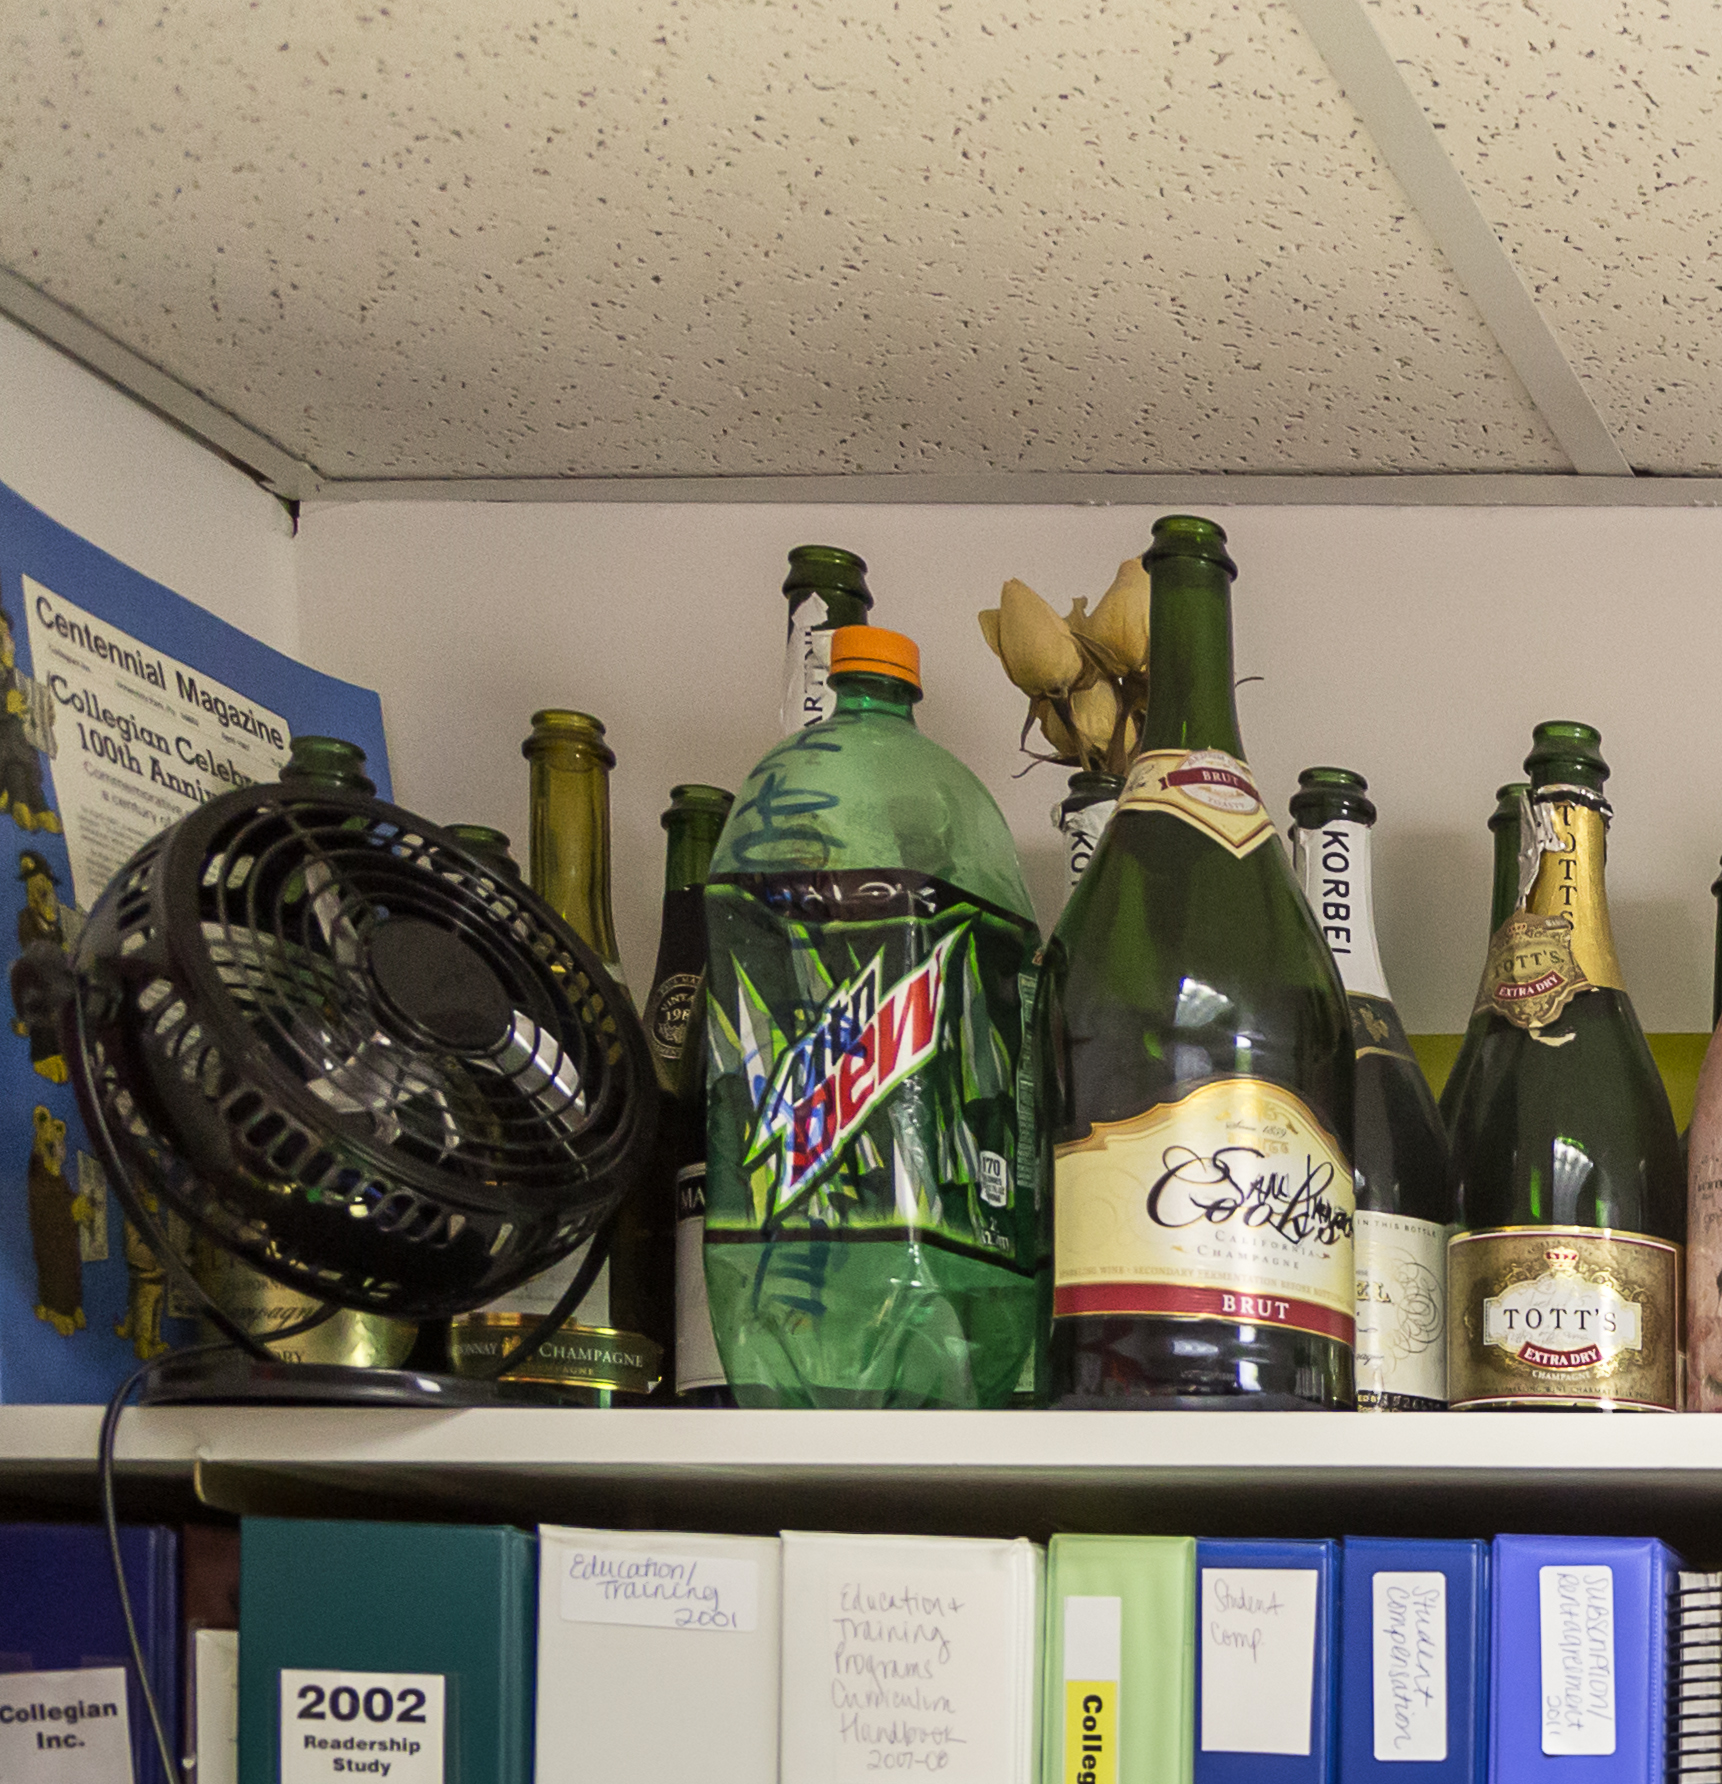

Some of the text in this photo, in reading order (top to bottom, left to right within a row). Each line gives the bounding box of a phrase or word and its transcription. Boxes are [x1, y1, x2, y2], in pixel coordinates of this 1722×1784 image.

[36, 596, 284, 750] Centennial Magazine
[48, 671, 172, 756] Collegian
[77, 722, 143, 776] 100th
[1222, 1295, 1289, 1319] BRUT
[1501, 1308, 1619, 1333] TOTT'S
[1524, 1345, 1598, 1368] EXTRA DRY
[0, 1699, 117, 1725] Collegian
[297, 1684, 426, 1723] 2002
[35, 1730, 86, 1750] Inc.
[304, 1734, 421, 1755] Readership
[333, 1757, 391, 1777] Study
